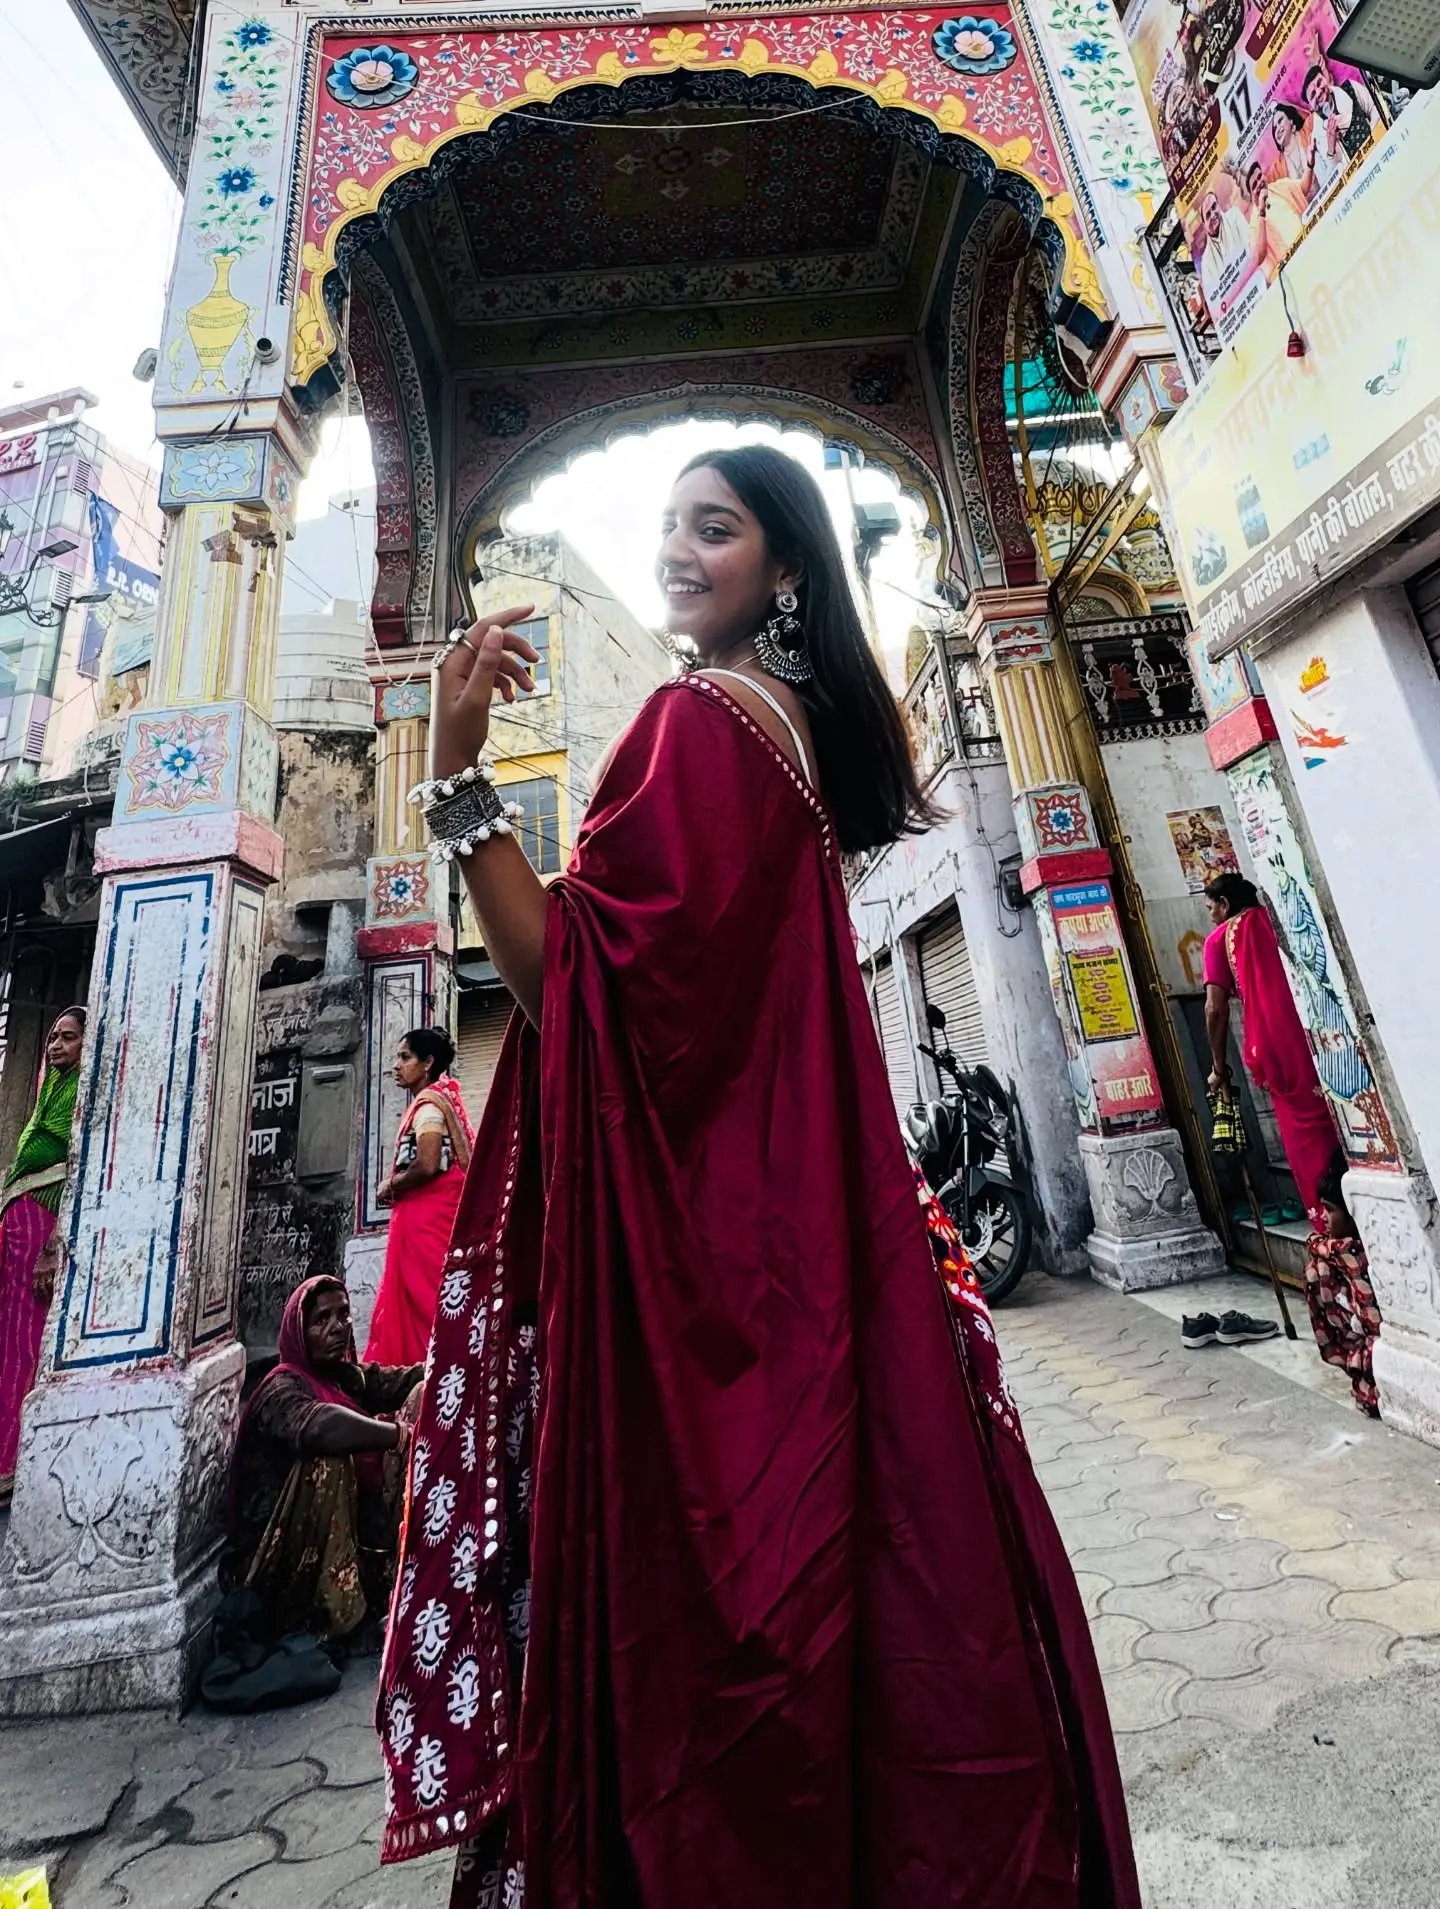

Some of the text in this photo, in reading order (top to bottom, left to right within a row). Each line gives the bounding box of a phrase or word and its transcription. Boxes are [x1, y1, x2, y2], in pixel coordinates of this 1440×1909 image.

[1228, 71, 1252, 132] 17
[1199, 116, 1214, 140] 2025
[1296, 511, 1329, 564] पानी
[1324, 496, 1348, 544] की
[1386, 441, 1425, 492] बटर
[1104, 1079, 1131, 1102] बाहर
